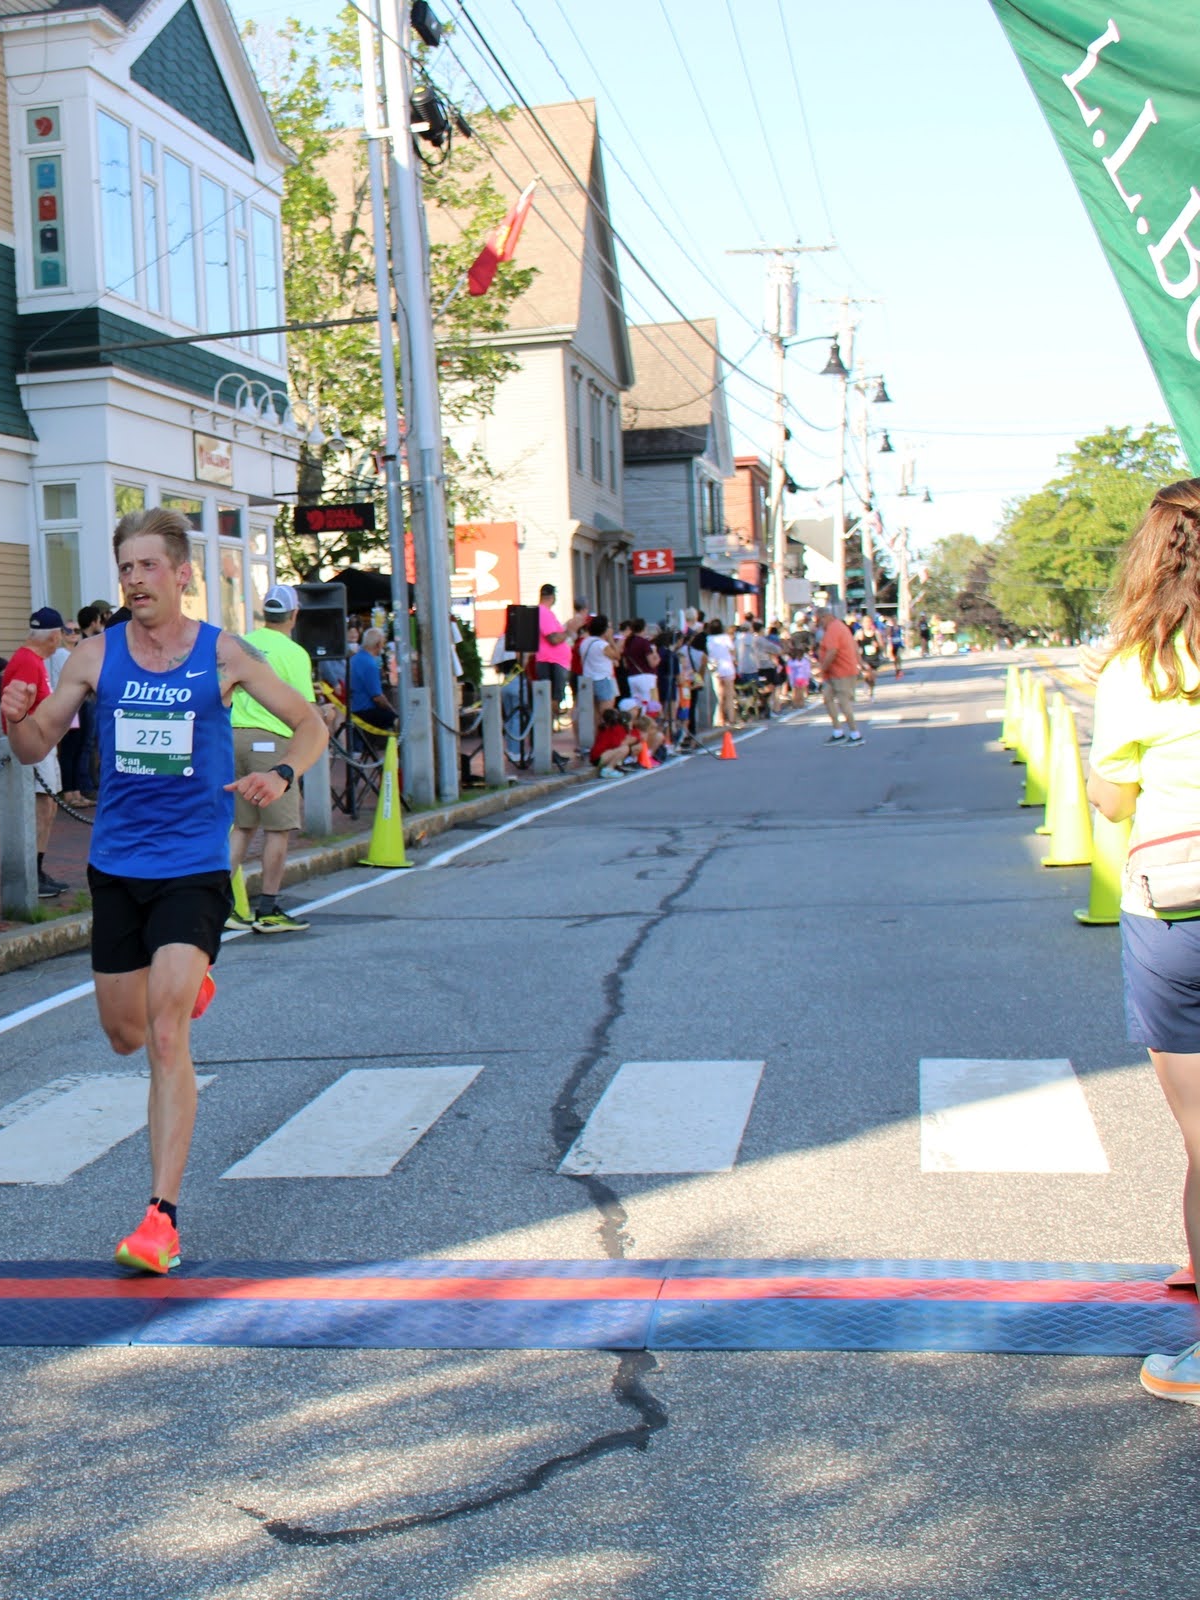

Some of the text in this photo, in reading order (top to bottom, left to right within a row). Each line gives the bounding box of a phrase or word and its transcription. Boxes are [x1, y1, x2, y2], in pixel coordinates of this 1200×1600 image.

[1061, 18, 1200, 361] L.L.B
[118, 681, 192, 706] Dirigo
[136, 730, 172, 746] 275
